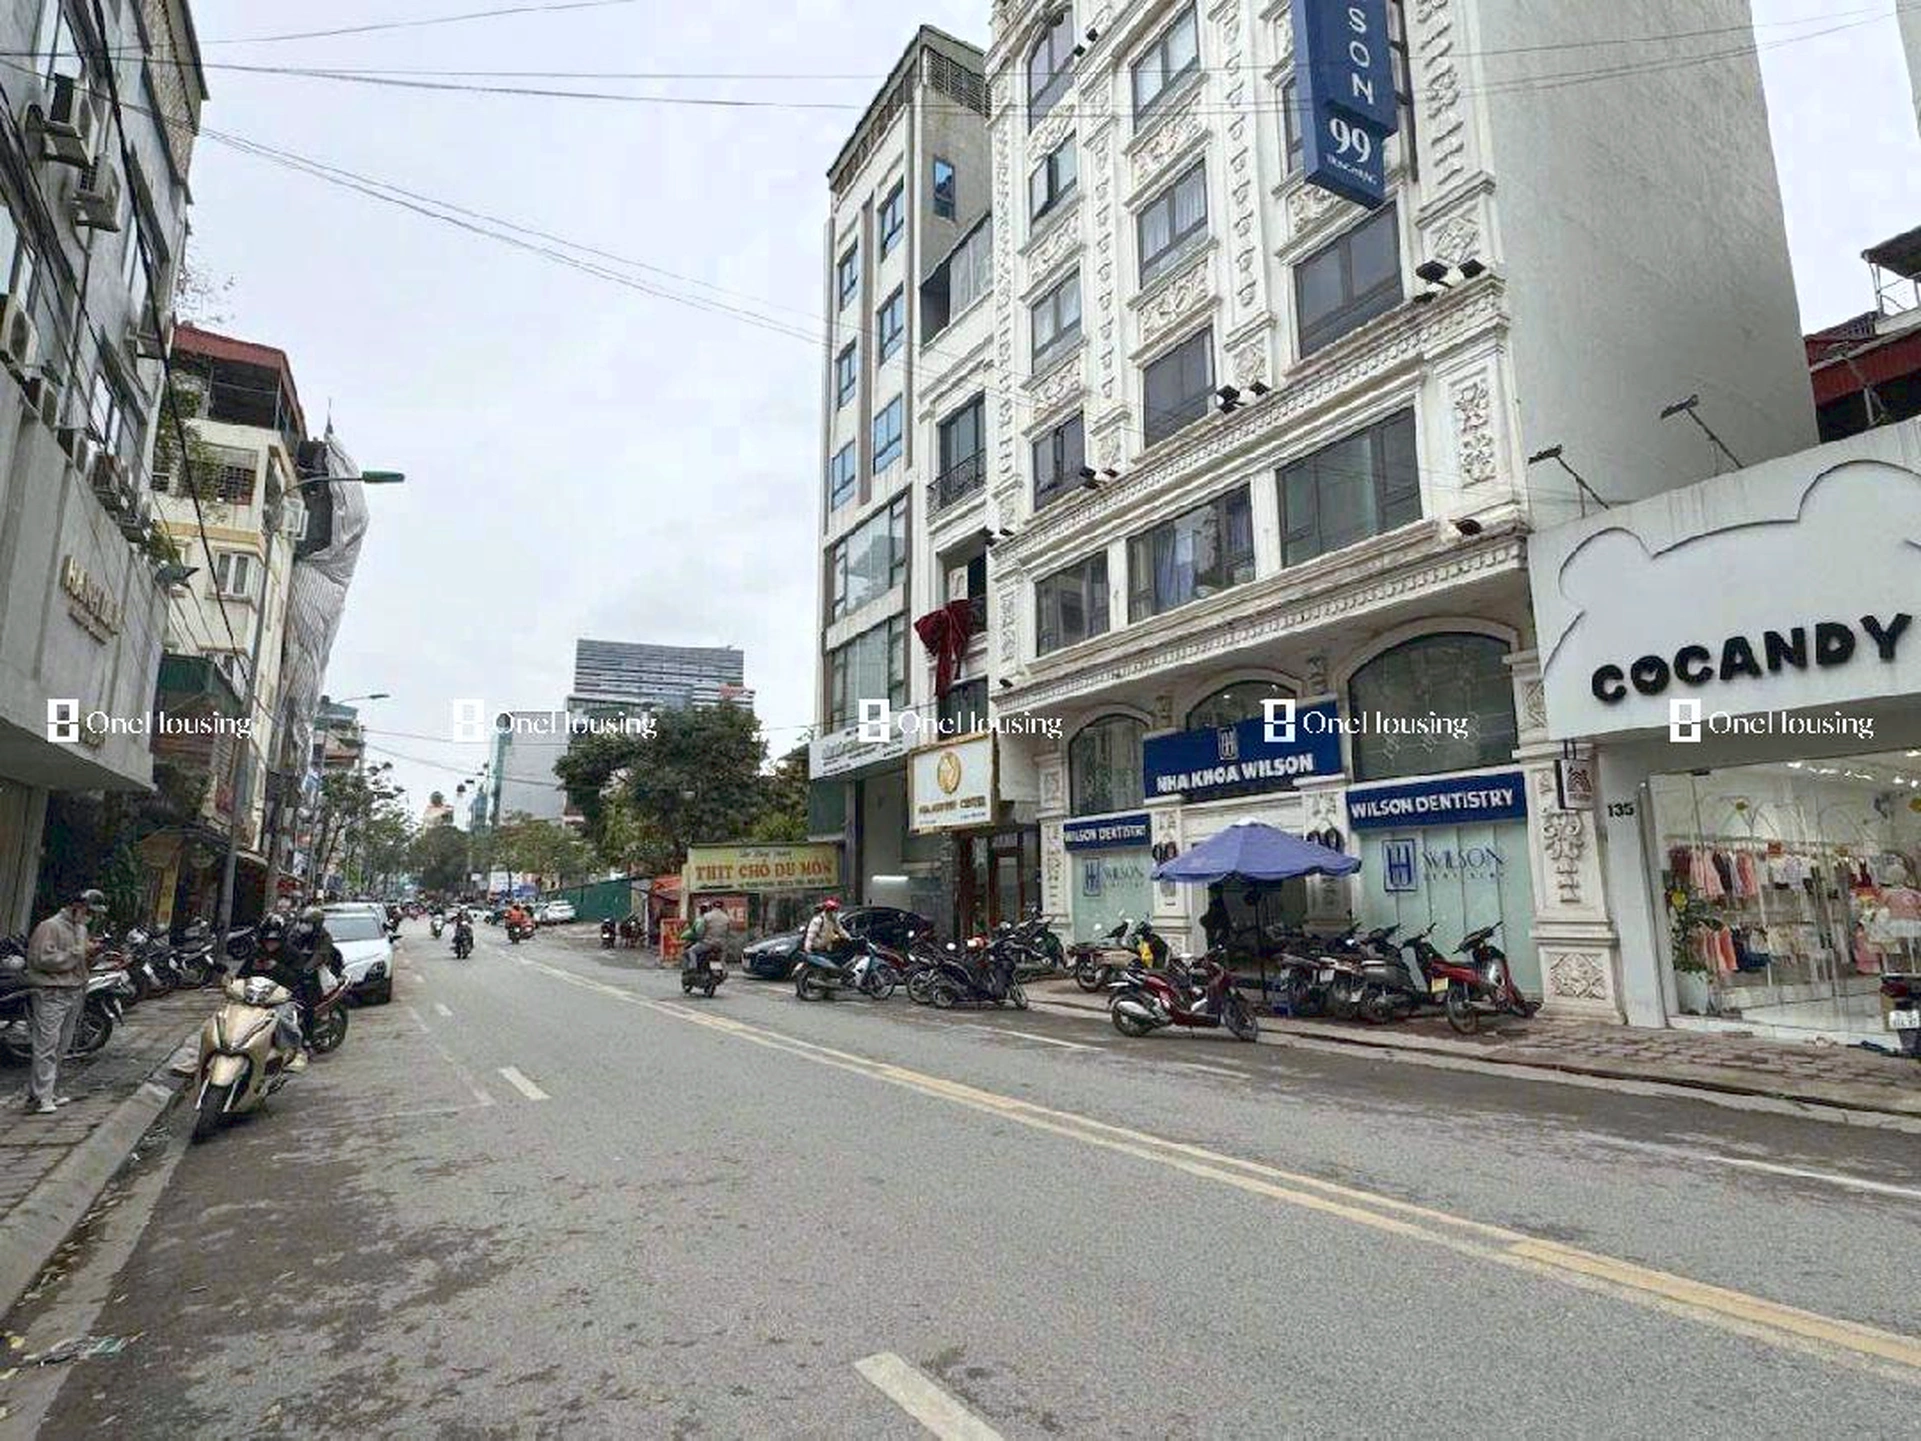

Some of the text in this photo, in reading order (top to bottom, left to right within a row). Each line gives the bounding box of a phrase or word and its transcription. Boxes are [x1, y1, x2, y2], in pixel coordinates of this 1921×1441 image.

[1329, 118, 1371, 163] 99
[1591, 612, 1913, 704] COCANDY
[1156, 752, 1315, 793] NHA KHOA WILSON
[1350, 788, 1514, 819] WILSON DENTISTRY
[1607, 802, 1635, 818] 135
